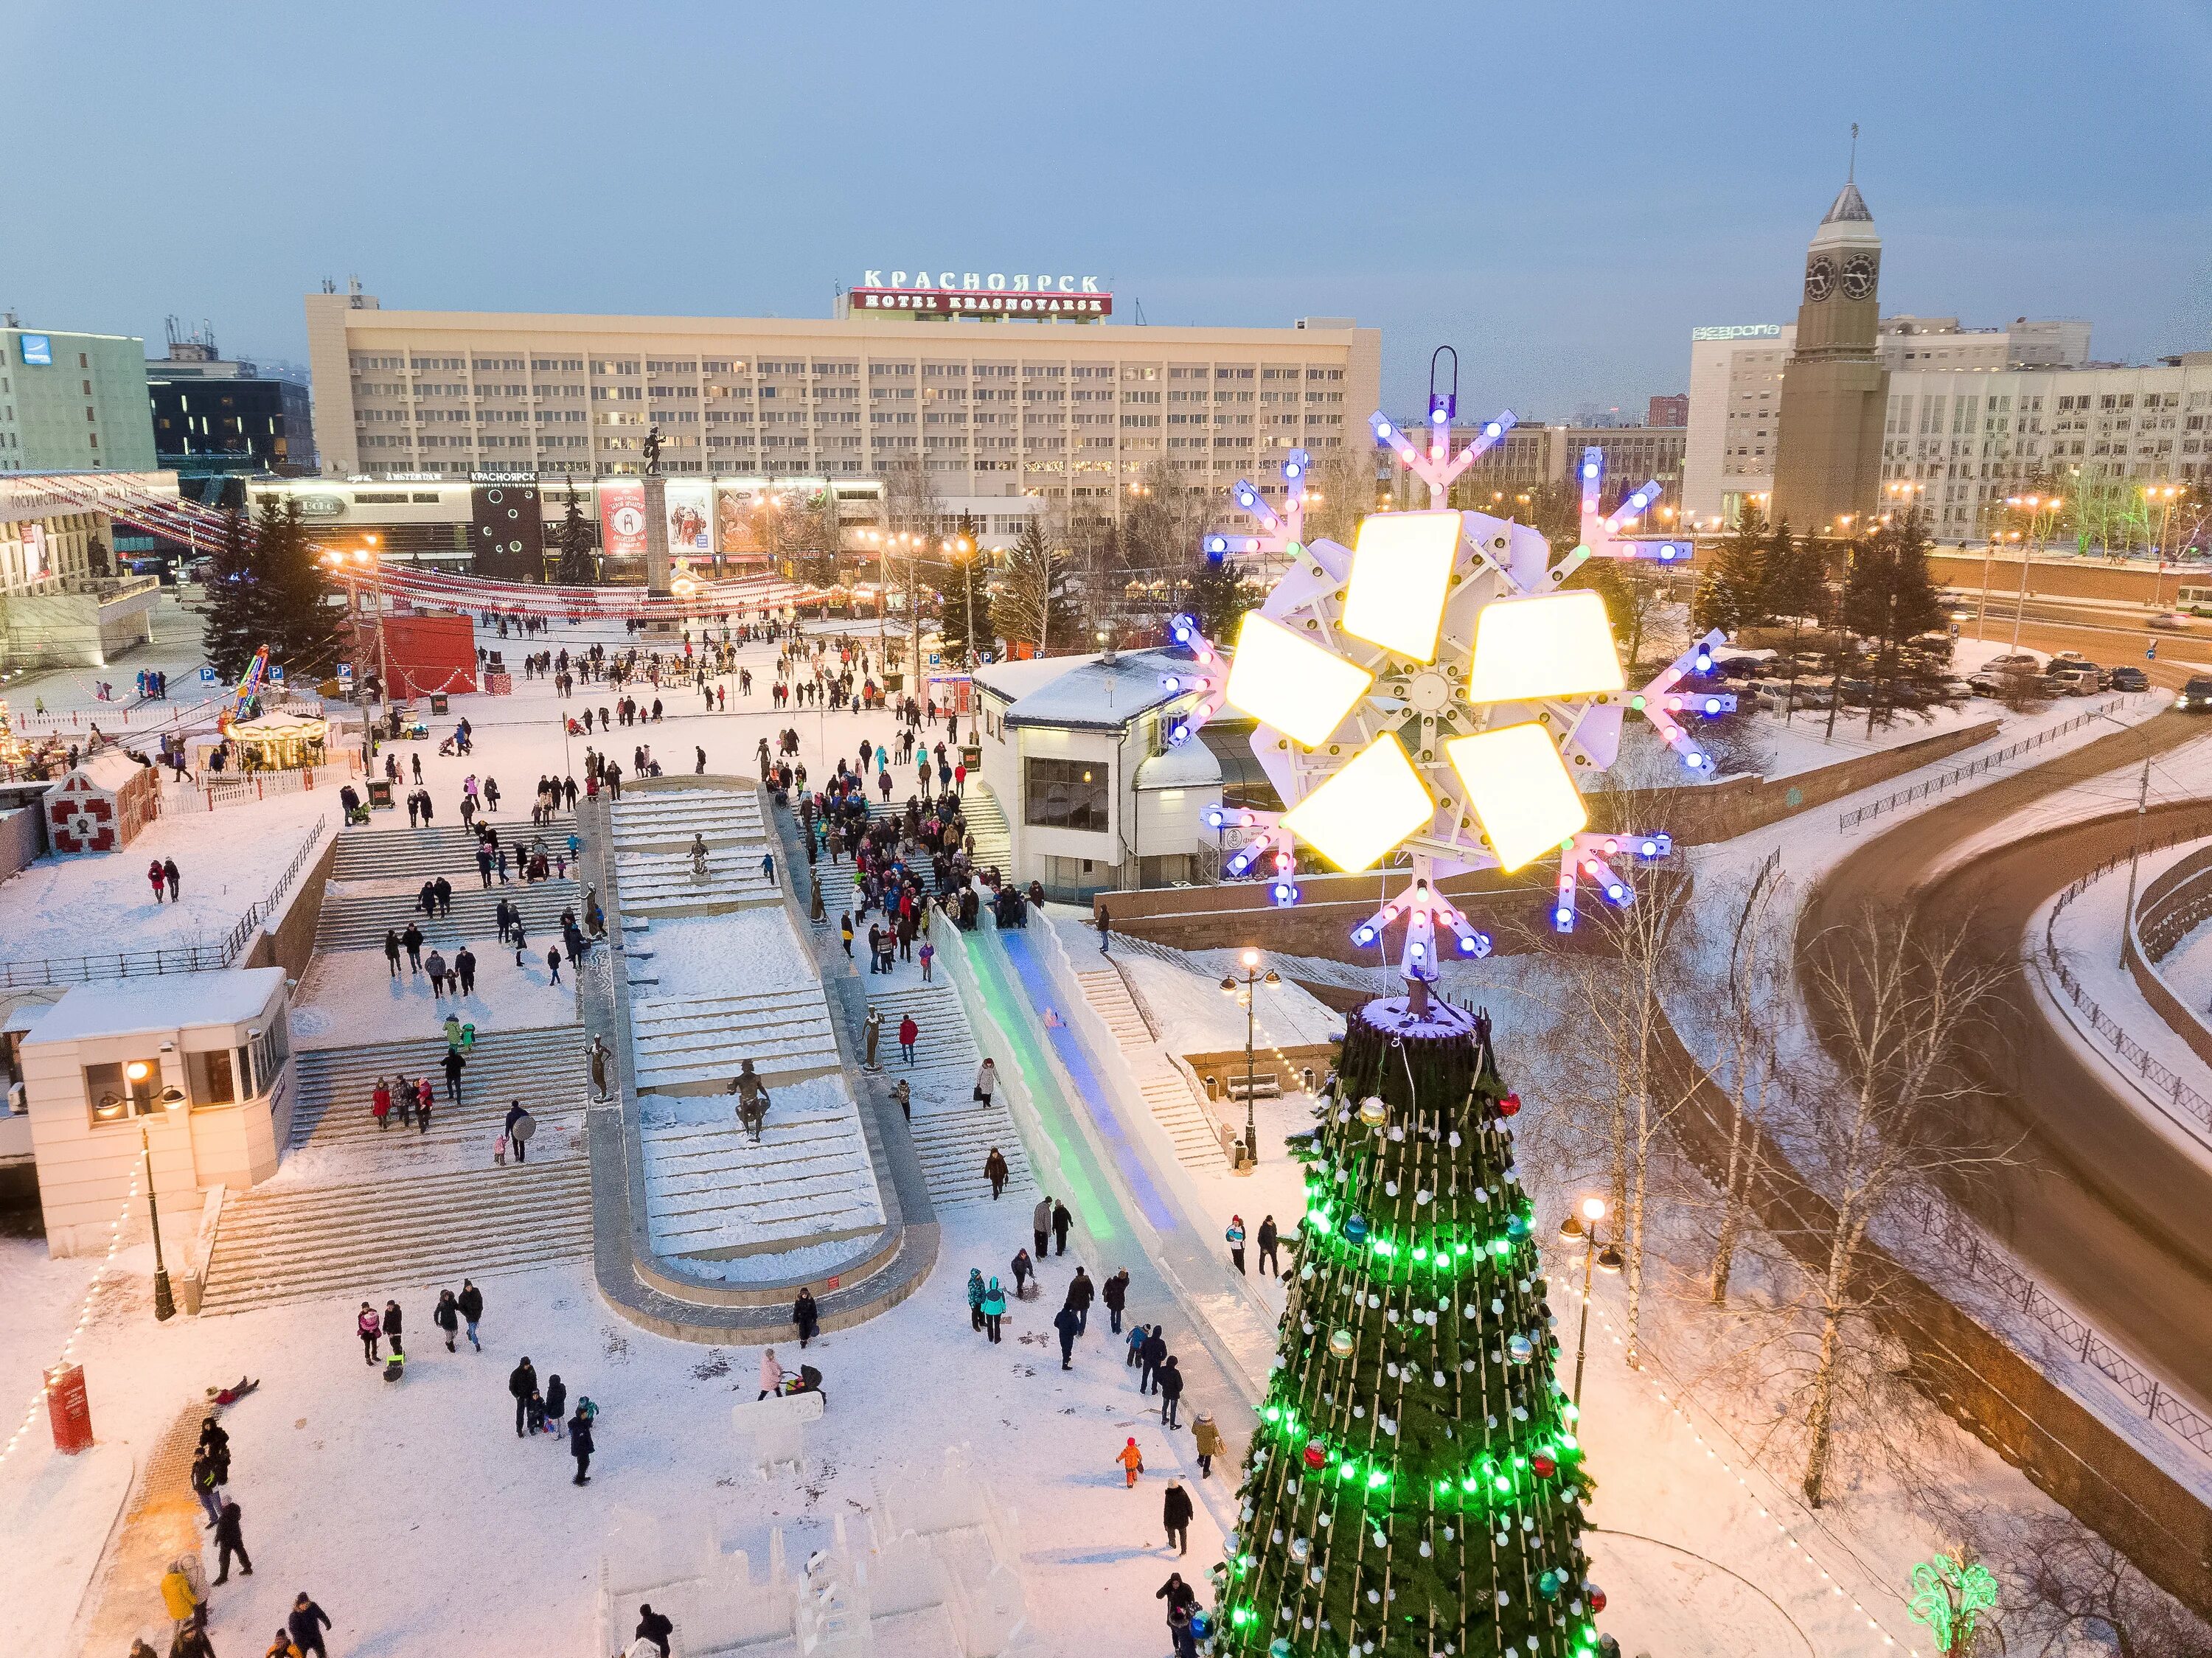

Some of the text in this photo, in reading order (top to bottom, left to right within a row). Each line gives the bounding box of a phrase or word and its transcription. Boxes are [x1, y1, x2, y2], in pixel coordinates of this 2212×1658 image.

[864, 270, 1099, 293] КРАСНОЯРСК
[865, 295, 1102, 311] HOTEL KRASNOYARSK
[471, 472, 536, 481] КРАСНОЯРСК
